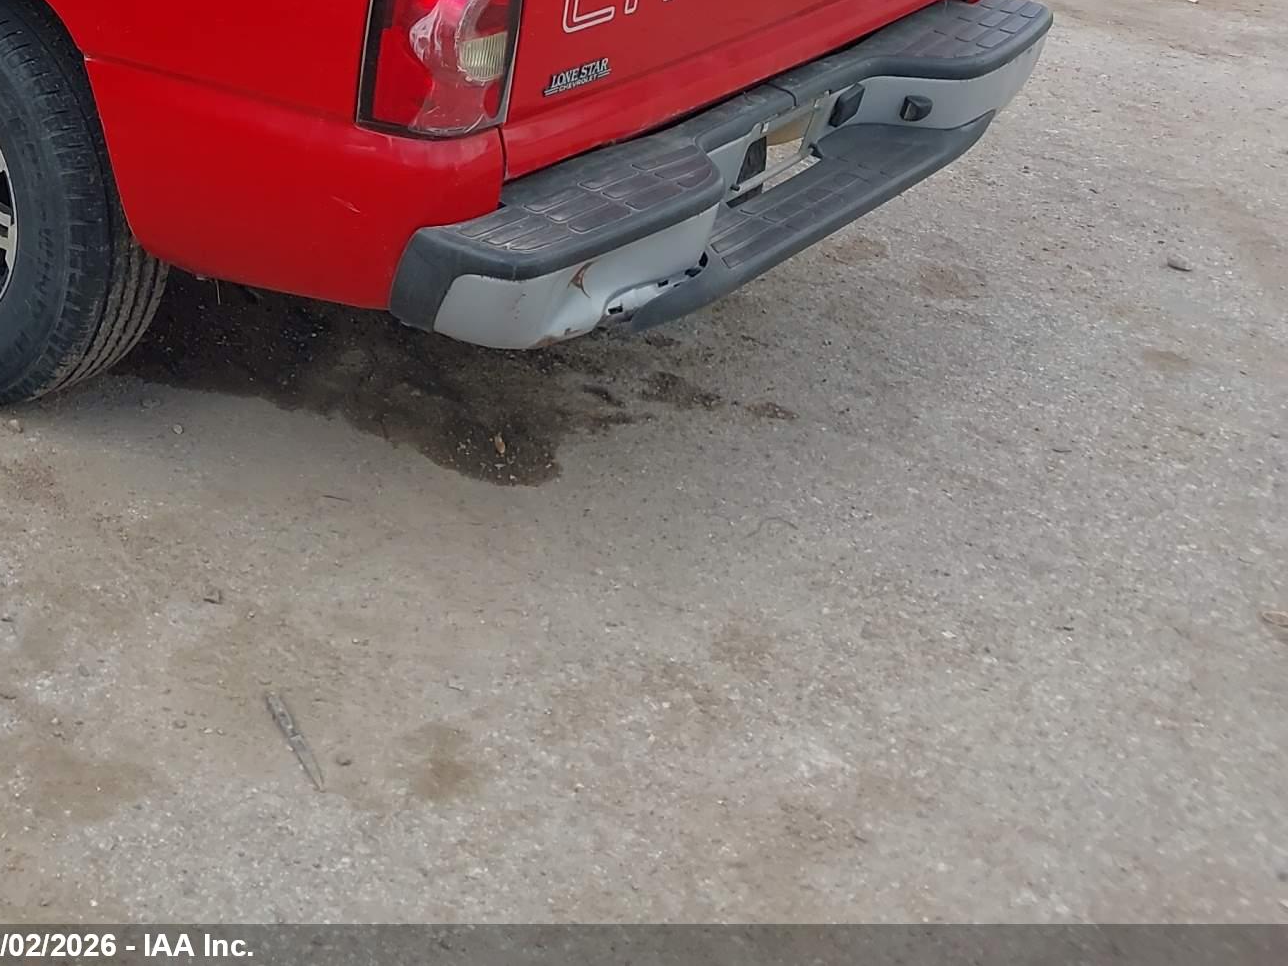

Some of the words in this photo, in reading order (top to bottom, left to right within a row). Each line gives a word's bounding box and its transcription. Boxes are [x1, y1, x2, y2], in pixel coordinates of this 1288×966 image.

[551, 68, 579, 88] LONE
[580, 58, 608, 78] STAR
[559, 74, 597, 92] CHEVROLET
